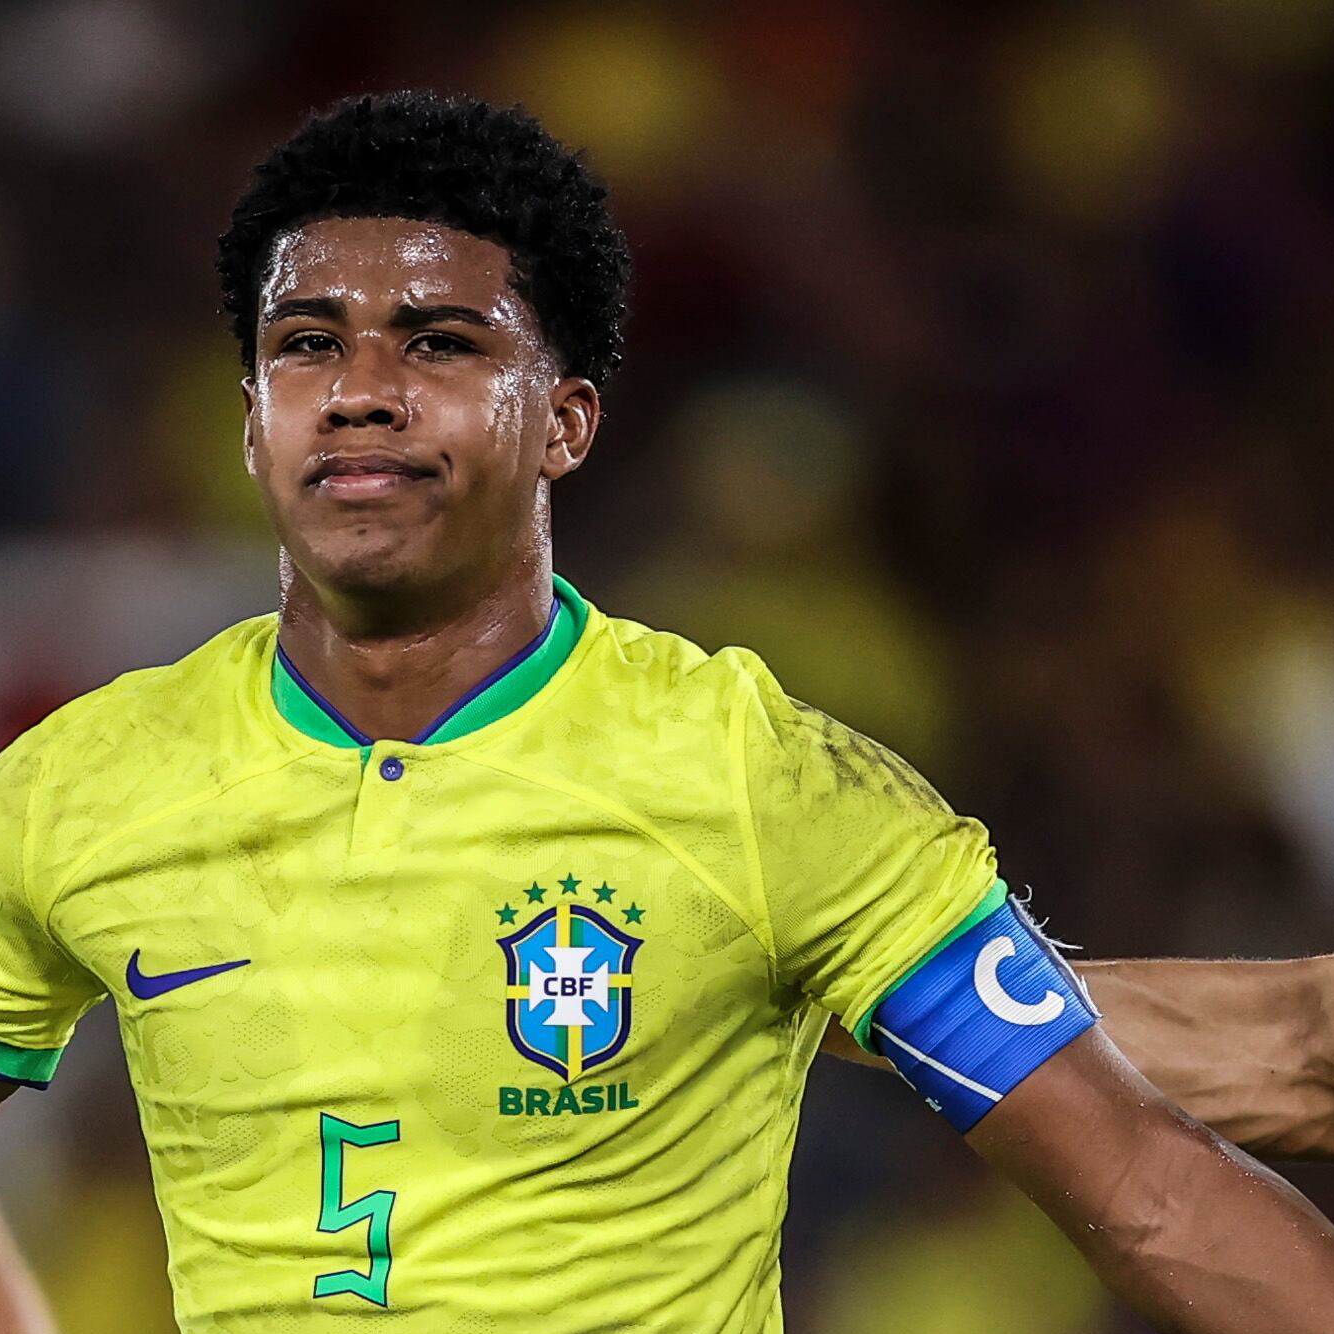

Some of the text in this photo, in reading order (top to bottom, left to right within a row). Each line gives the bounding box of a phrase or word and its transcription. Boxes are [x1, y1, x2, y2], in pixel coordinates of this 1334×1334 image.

[543, 976, 595, 997] CBF
[973, 935, 1066, 1026] C
[499, 1081, 640, 1117] BRASIL
[313, 1111, 401, 1309] 5
